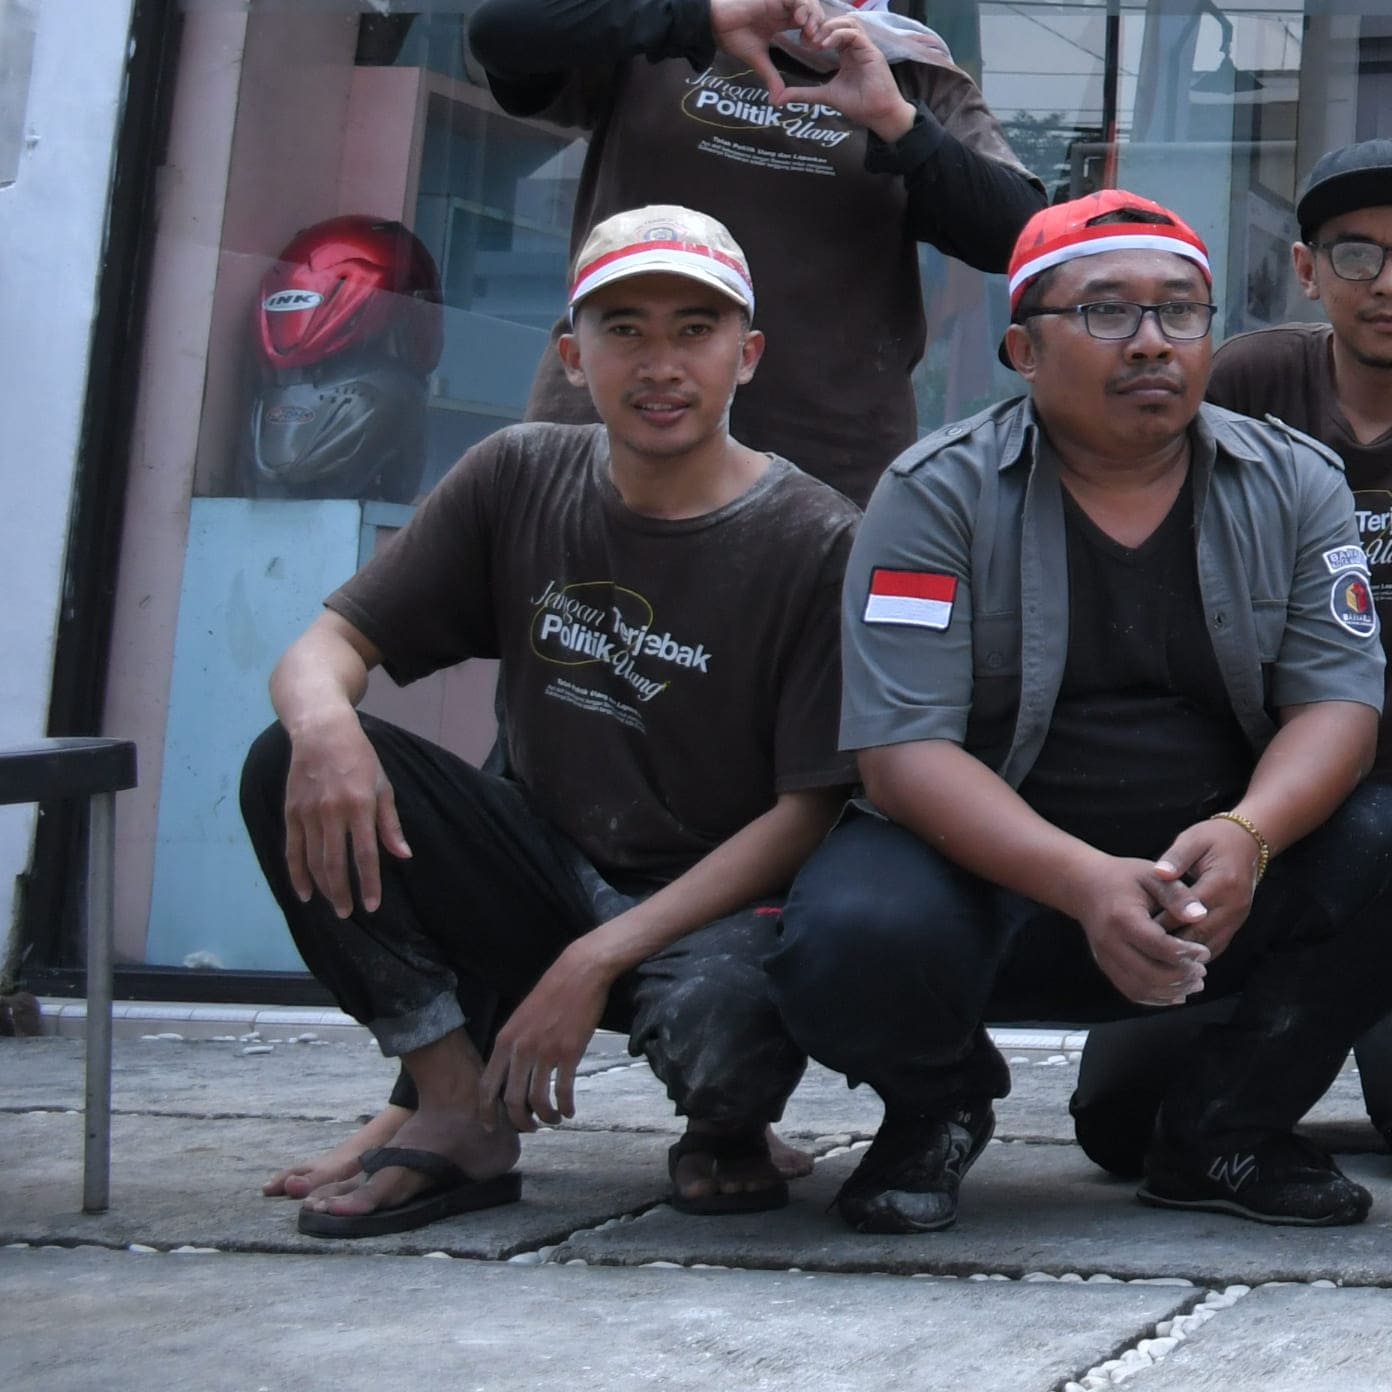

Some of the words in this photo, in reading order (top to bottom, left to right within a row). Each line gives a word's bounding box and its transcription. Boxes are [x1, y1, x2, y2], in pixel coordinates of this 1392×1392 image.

[685, 66, 770, 102] Jangan
[695, 90, 784, 127] Politik
[781, 119, 854, 149] Uang
[268, 294, 315, 307] INK
[530, 580, 607, 628] Jangan
[612, 606, 713, 674] Terjebak
[540, 613, 617, 664] Politik
[611, 649, 668, 702] Uang
